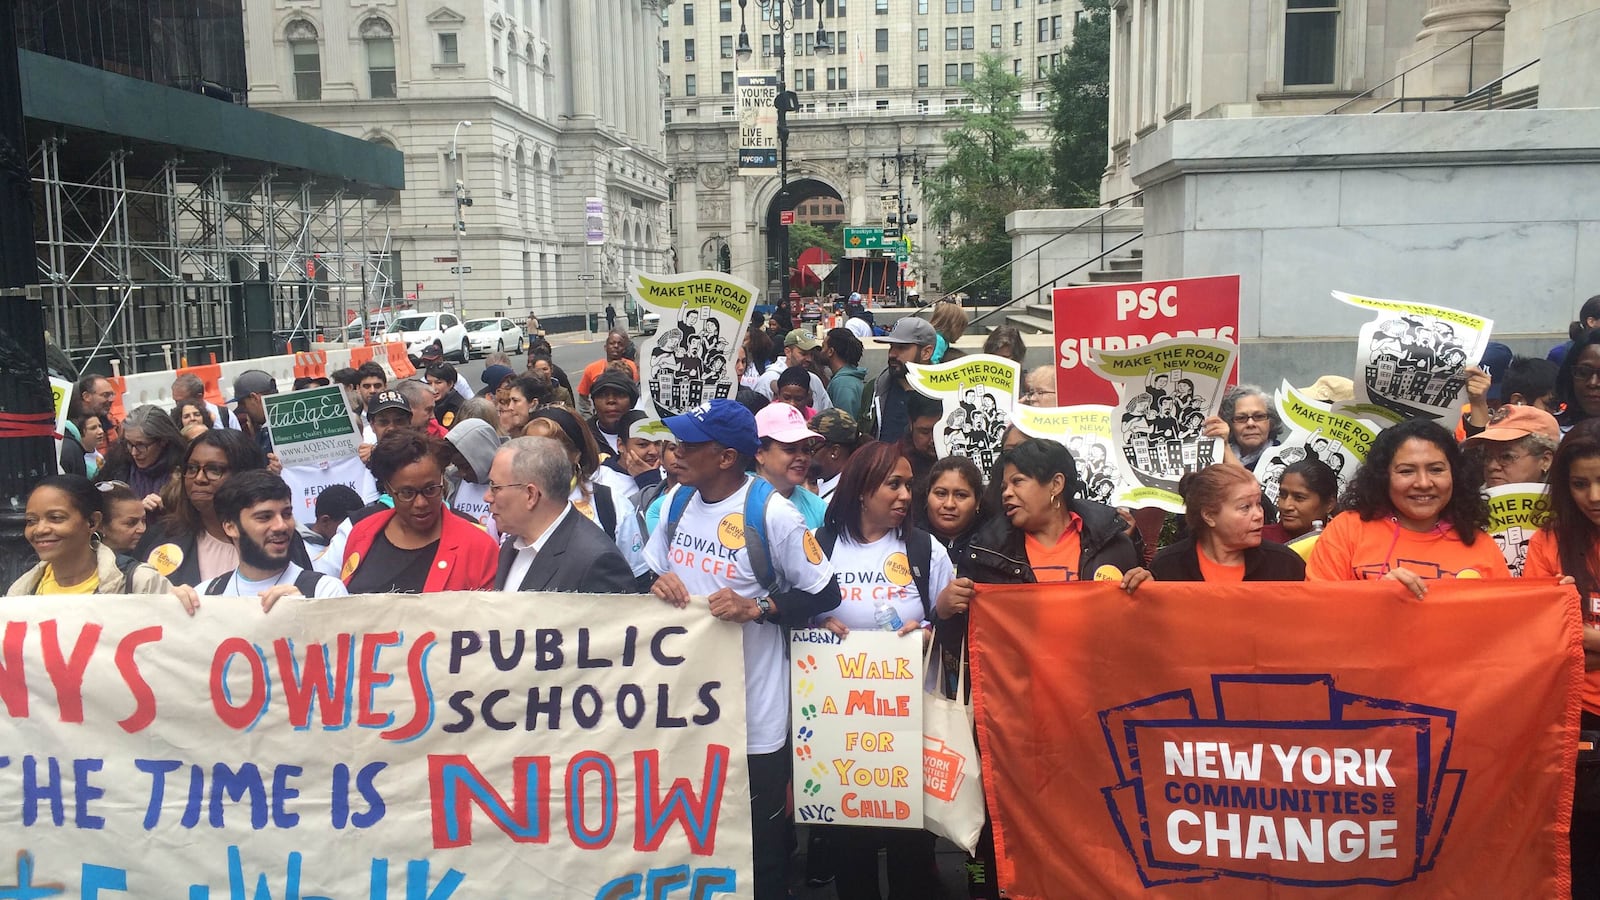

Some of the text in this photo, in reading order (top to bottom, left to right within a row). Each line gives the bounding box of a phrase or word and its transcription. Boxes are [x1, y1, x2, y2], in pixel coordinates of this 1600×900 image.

[741, 88, 775, 97] YOU'RE
[742, 98, 751, 107] IN
[742, 128, 762, 137] LIVE
[742, 138, 775, 147] LIKE IT.
[741, 155, 764, 163] nycgo
[649, 283, 748, 305] MAKE THE ROAD
[1116, 286, 1178, 321] PSC
[695, 295, 743, 315] NEW YORK
[1060, 325, 1235, 369] SUPPS
[1113, 348, 1225, 369] MAKE THE ROAD
[1163, 359, 1221, 374] NEW YORK
[930, 364, 1012, 384] MAKE THE ROAD
[969, 375, 1011, 388] NEW YORK
[1032, 415, 1069, 426] MAKE
[1072, 414, 1098, 423] THE
[1291, 403, 1324, 424] MAKE
[1327, 415, 1353, 431] THE
[1080, 424, 1104, 432] NEW
[1330, 428, 1352, 443] NEW
[280, 439, 354, 457] www.AQENY.org
[304, 480, 357, 496] #EDWK
[1495, 513, 1529, 527] NEW
[668, 546, 737, 579] FOR CFE
[872, 586, 908, 601] CFE
[792, 631, 842, 645] ALBANY
[449, 626, 689, 674] PUBLIC
[836, 652, 914, 680] WALK
[209, 631, 438, 743] OWES
[442, 681, 722, 733] SCHOOLS
[821, 689, 910, 717] A MILE
[846, 732, 895, 752] FOR
[833, 758, 909, 788] YOUR
[1163, 741, 1397, 788] NEW YORK
[0, 744, 730, 856] HE TIME IS NOW
[841, 792, 911, 820] CHILD
[1164, 781, 1379, 816] COMMUNITIES
[1381, 791, 1396, 815] FOR
[798, 805, 836, 822] NYC
[1166, 809, 1398, 864] CHANGE
